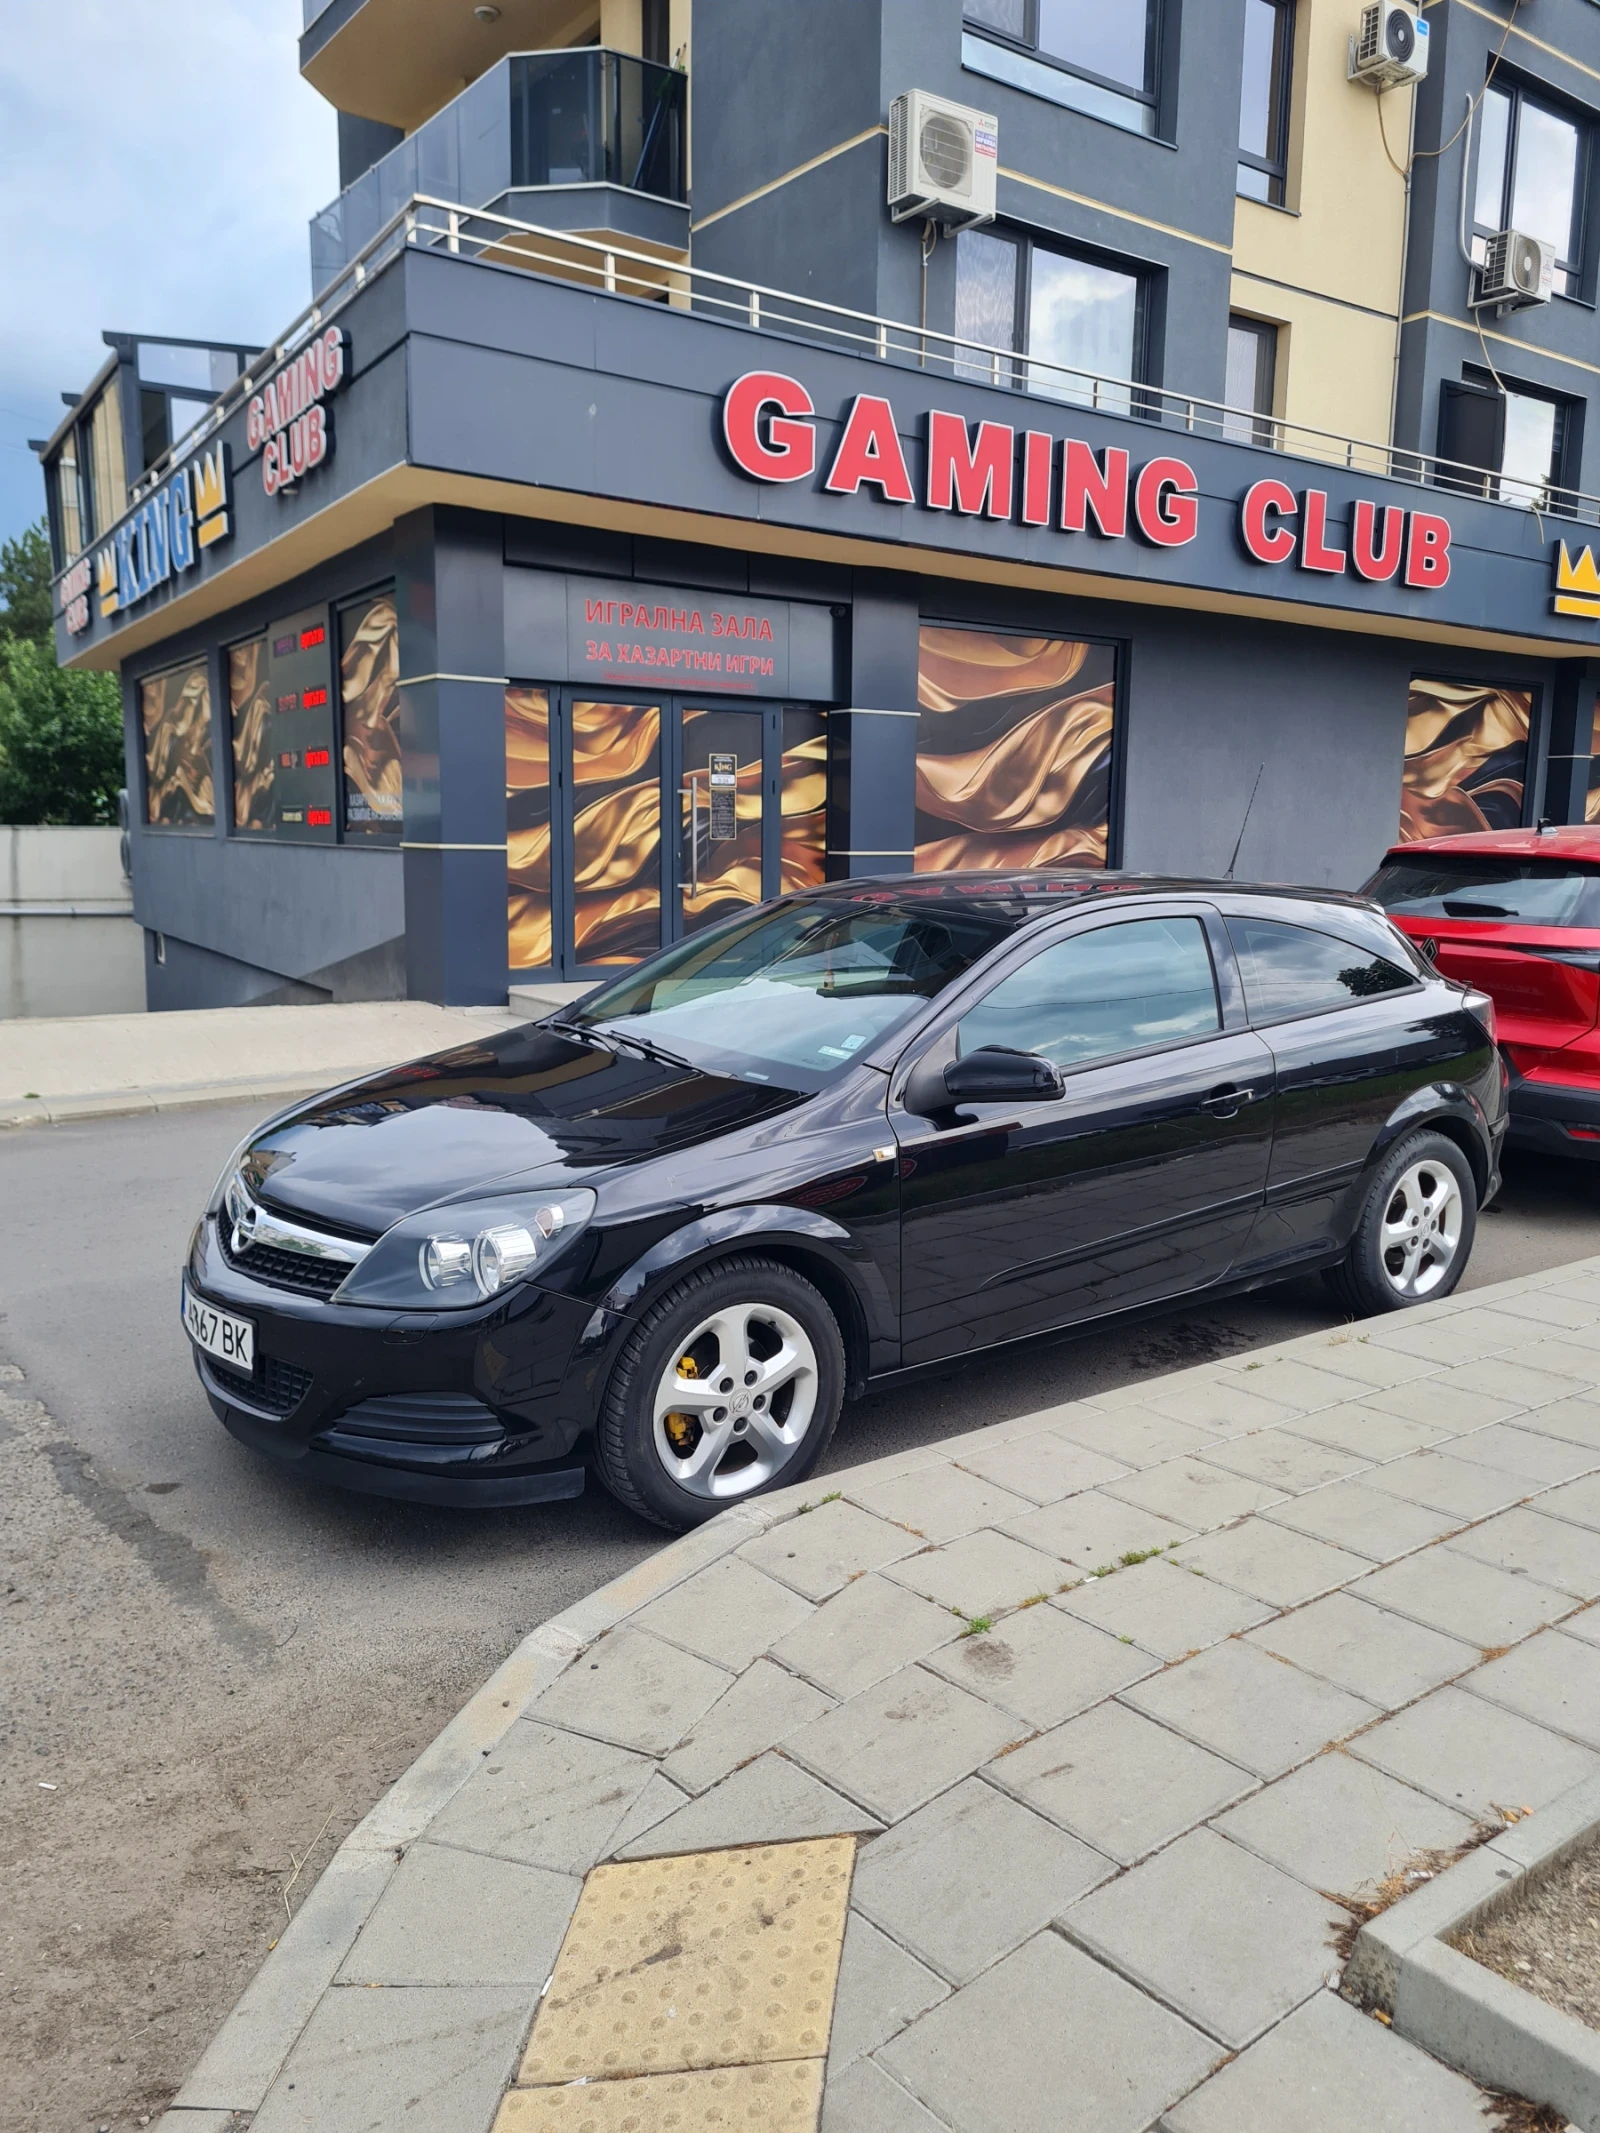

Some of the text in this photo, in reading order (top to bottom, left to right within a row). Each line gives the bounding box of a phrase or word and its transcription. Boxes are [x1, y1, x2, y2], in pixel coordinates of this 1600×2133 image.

[247, 325, 343, 451] GAMING
[262, 404, 327, 496] CLUB
[723, 369, 1453, 589] GAMING CLUB
[115, 467, 194, 609] KING
[585, 598, 773, 642] ИГРАЛНА ЗАЛА
[586, 640, 774, 676] ЗА ХАЗАРТНИ ИГРИ
[222, 1319, 248, 1363] BK
